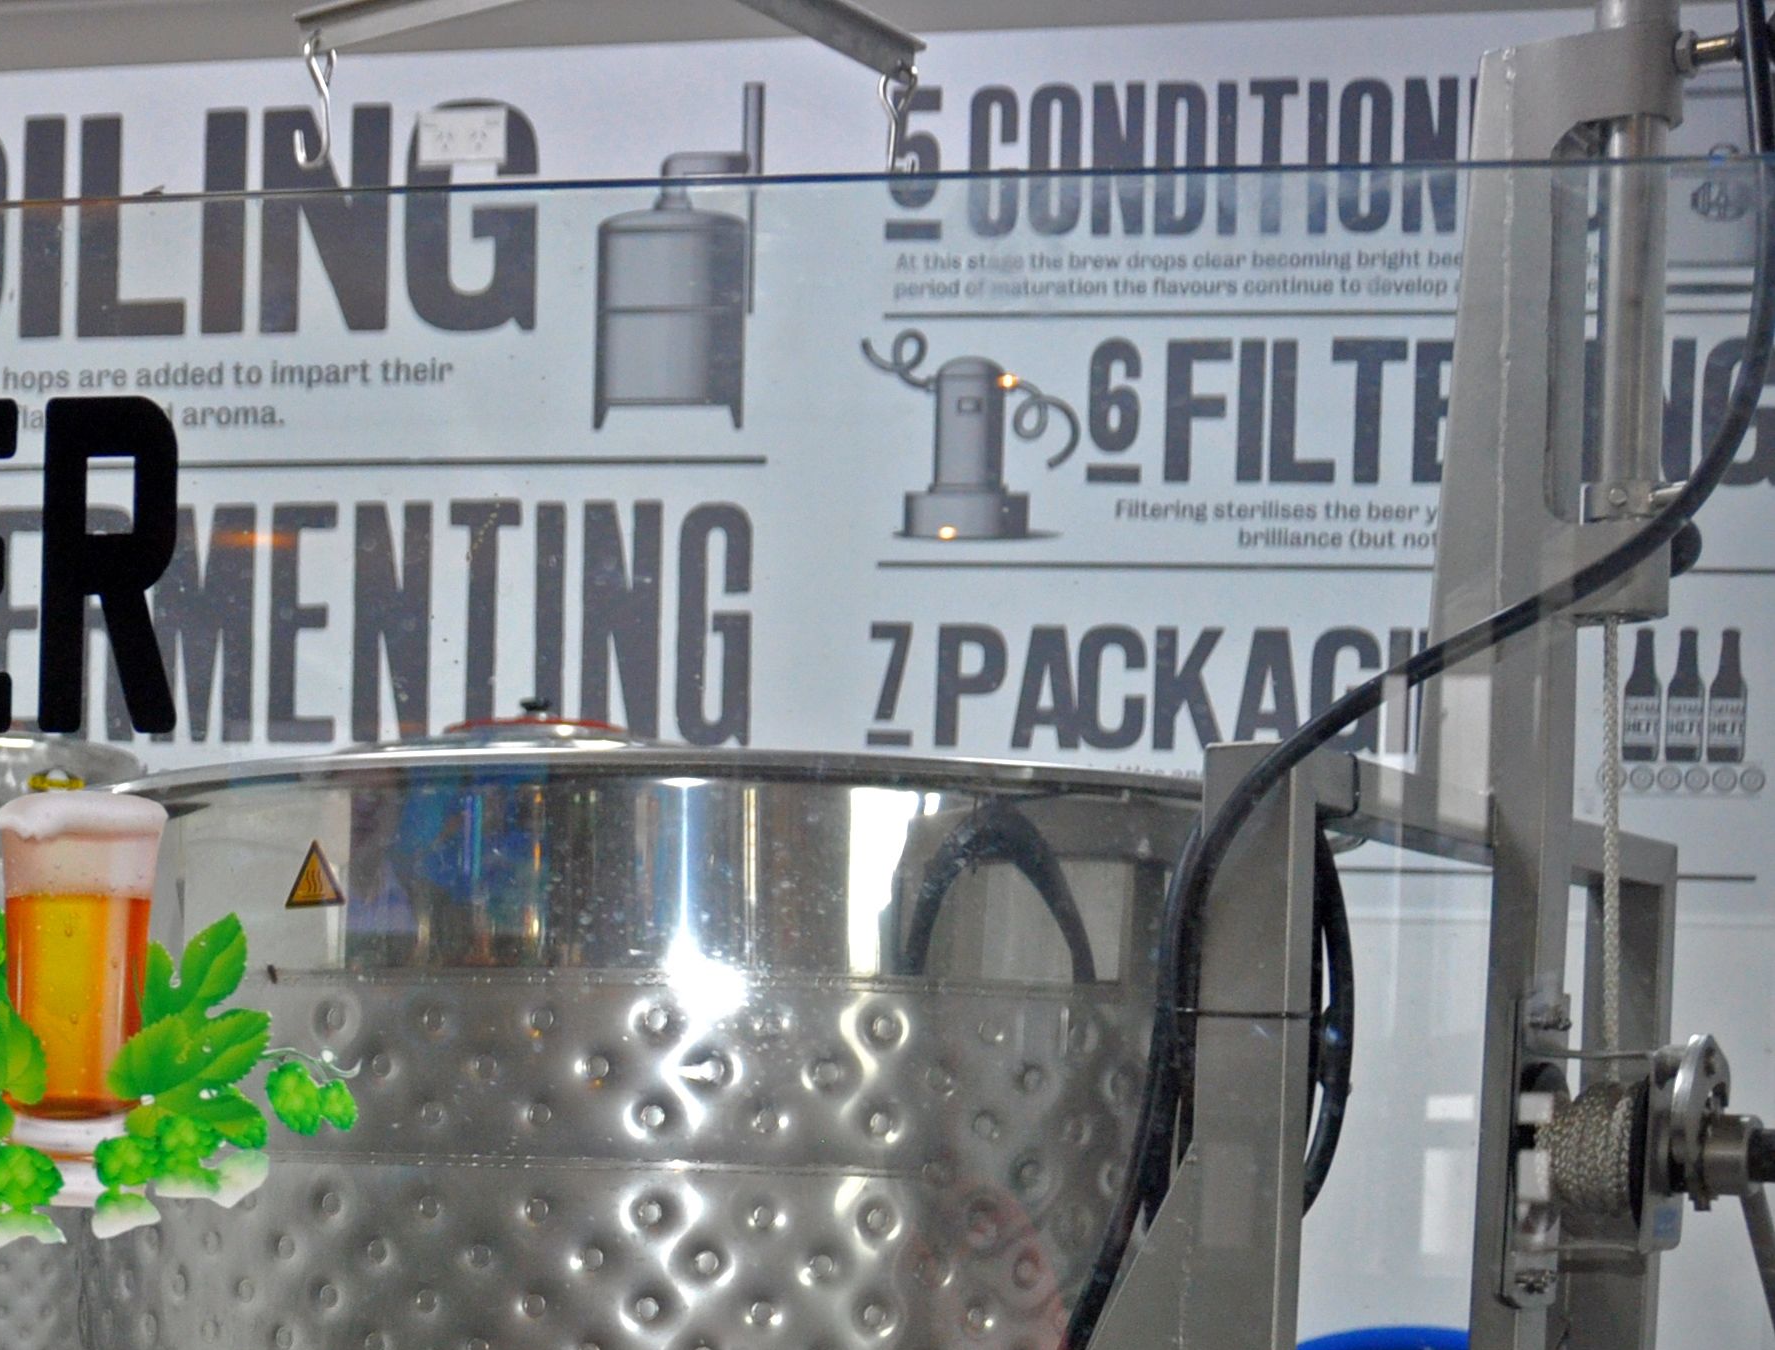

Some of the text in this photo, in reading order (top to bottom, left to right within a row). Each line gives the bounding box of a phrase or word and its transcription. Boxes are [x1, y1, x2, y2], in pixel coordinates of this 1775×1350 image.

[888, 76, 1479, 238] 5 CONDITION
[924, 252, 963, 270] this
[1029, 251, 1063, 270] the
[1068, 251, 1121, 269] brew
[1128, 251, 1187, 272] drops
[1193, 251, 1245, 269] clear
[1252, 250, 1351, 271] becoming
[1358, 249, 1420, 270] bright
[893, 279, 960, 299] period
[992, 276, 1107, 296] maturation
[1113, 277, 1147, 296] the
[1154, 276, 1238, 296] flavours
[1244, 275, 1334, 295] continue
[1341, 276, 1361, 295] to
[1368, 276, 1448, 297] develop
[3, 366, 70, 394] hops
[79, 367, 127, 389] are
[136, 361, 224, 388] added
[233, 363, 263, 387] to
[271, 358, 372, 389] impart
[381, 357, 454, 385] their
[1087, 337, 1142, 453] 6
[182, 405, 285, 427] aroma.
[1115, 500, 1208, 524] Filtering
[1212, 499, 1318, 522] sterilises
[1324, 500, 1361, 522] the
[1367, 500, 1420, 522] beer
[1238, 528, 1343, 550] brilliance
[1349, 528, 1396, 551] (but
[870, 621, 913, 722] 7
